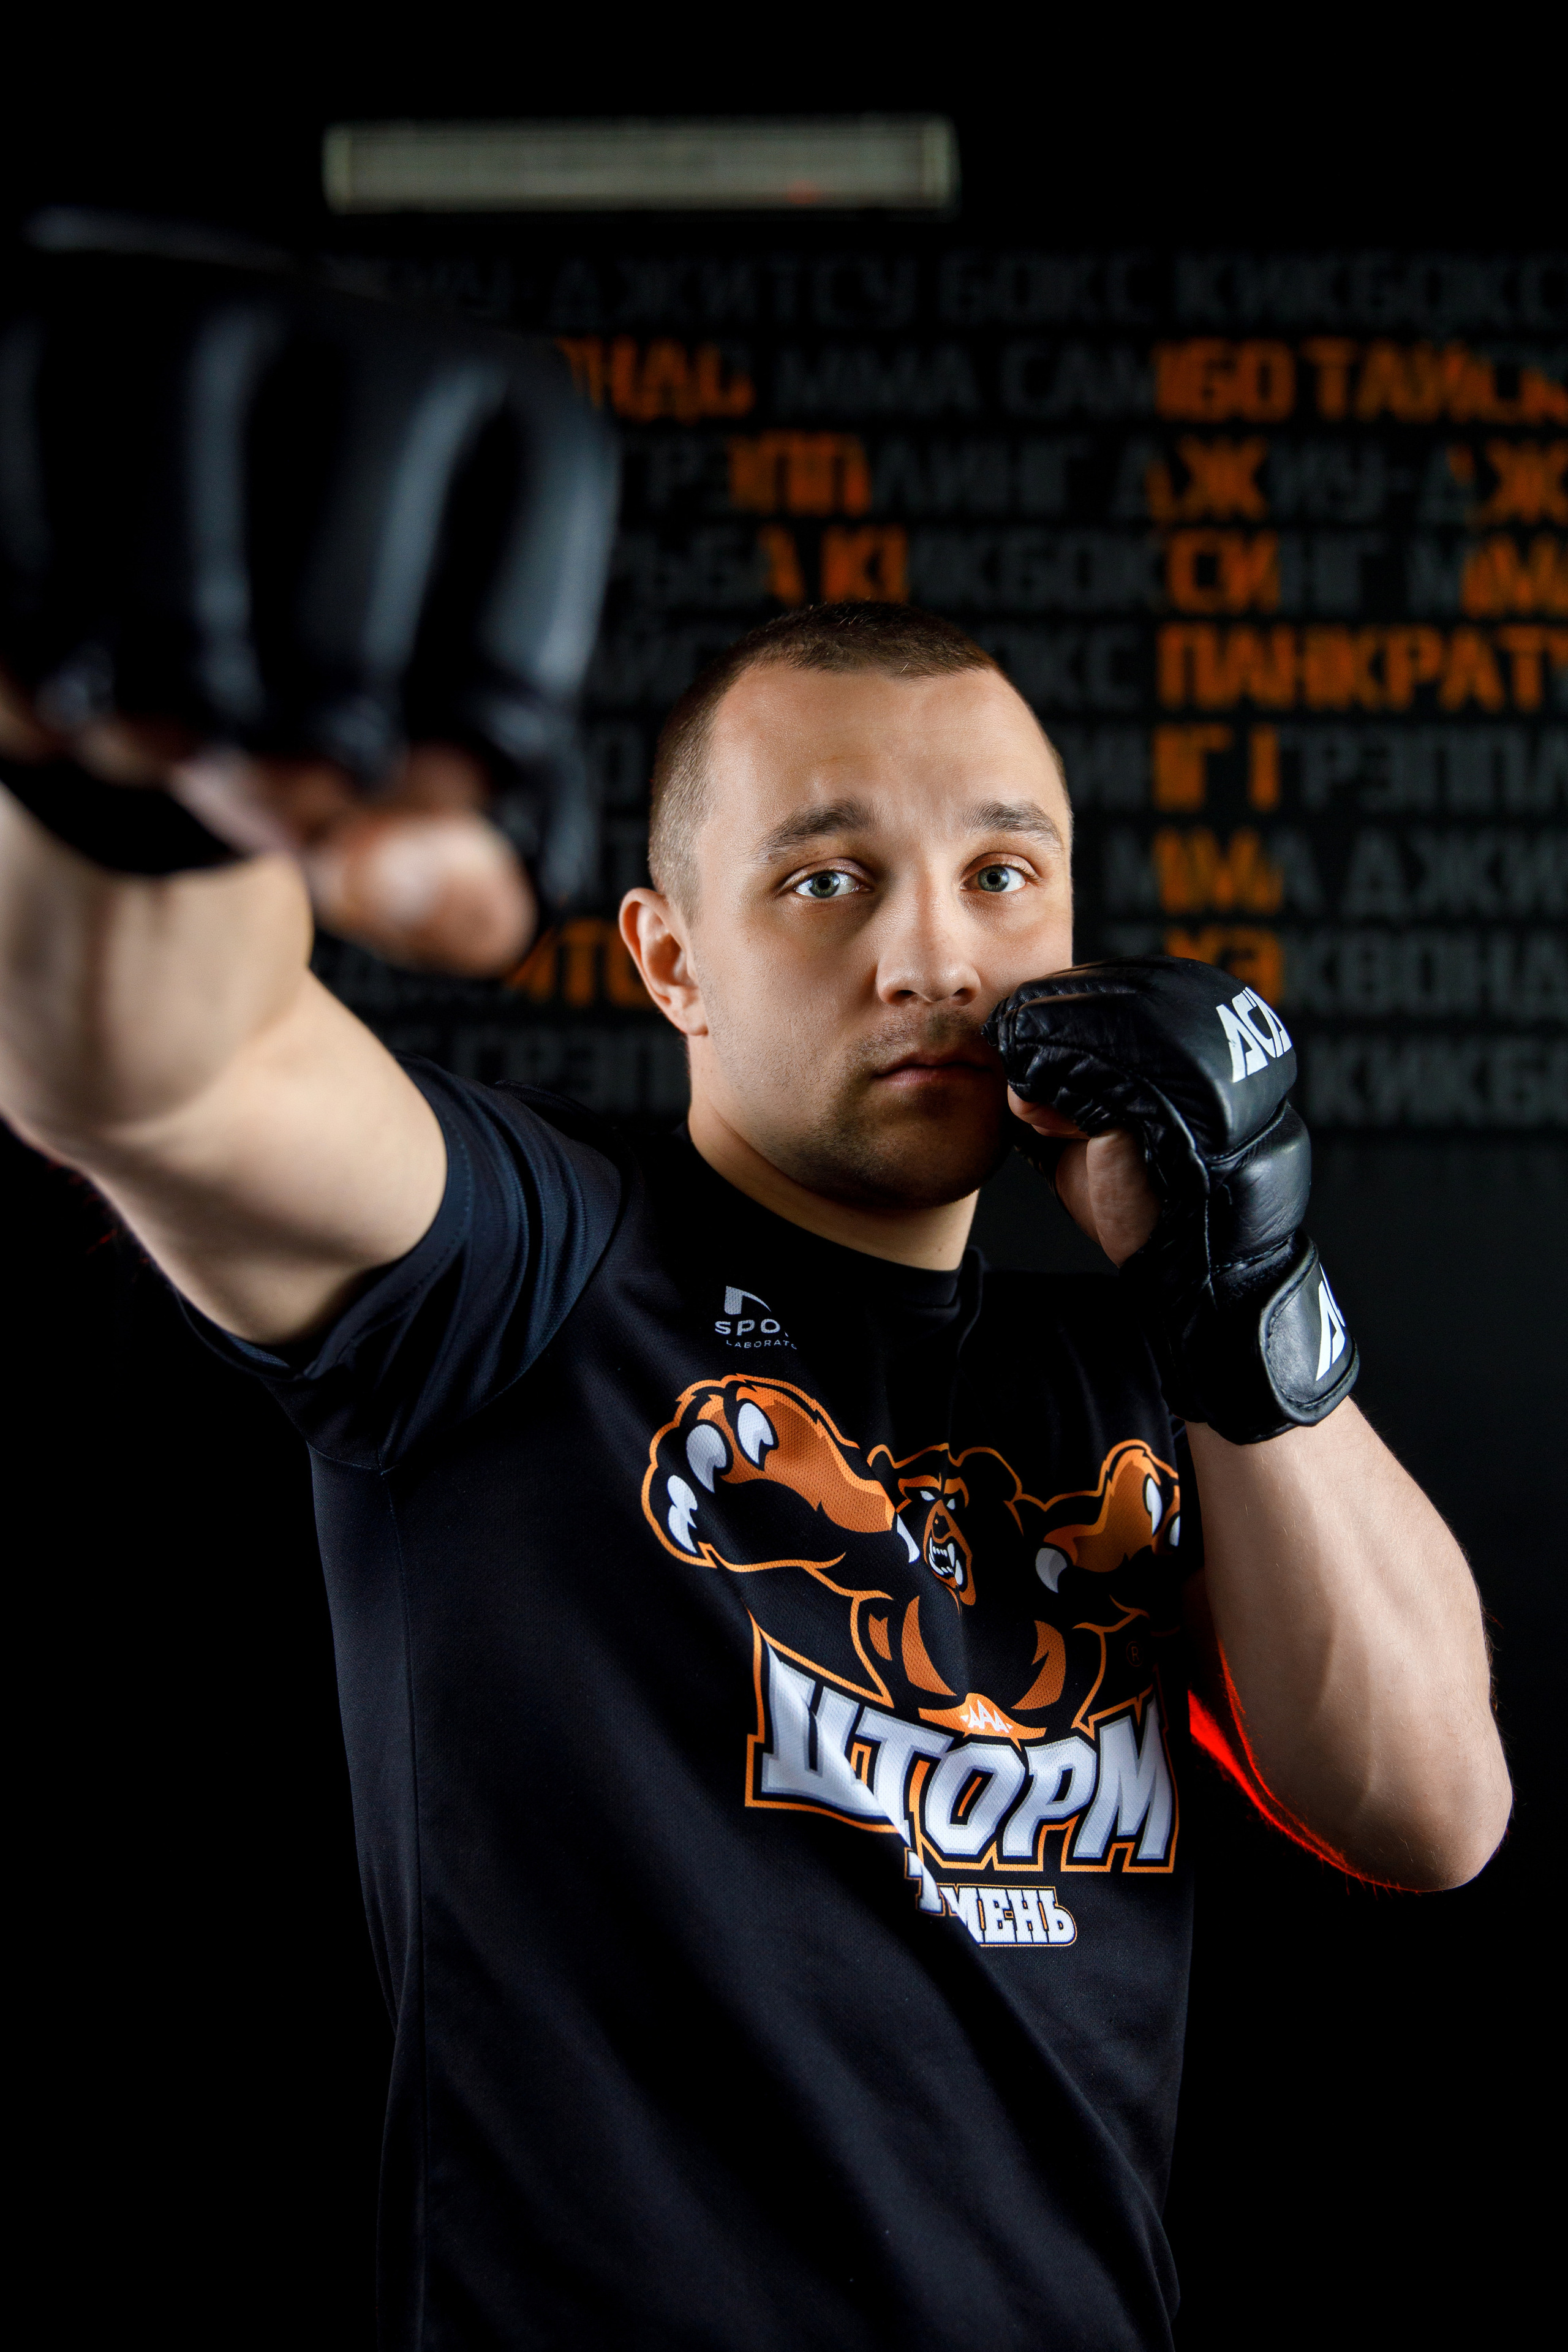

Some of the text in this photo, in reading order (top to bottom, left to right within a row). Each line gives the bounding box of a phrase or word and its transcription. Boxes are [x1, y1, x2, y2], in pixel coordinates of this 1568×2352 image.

[936, 250, 1158, 330] БОКС
[769, 338, 981, 423] ММА
[997, 336, 1296, 424] САМБО
[1102, 823, 1328, 919] ММА
[714, 1318, 789, 1336] SPO
